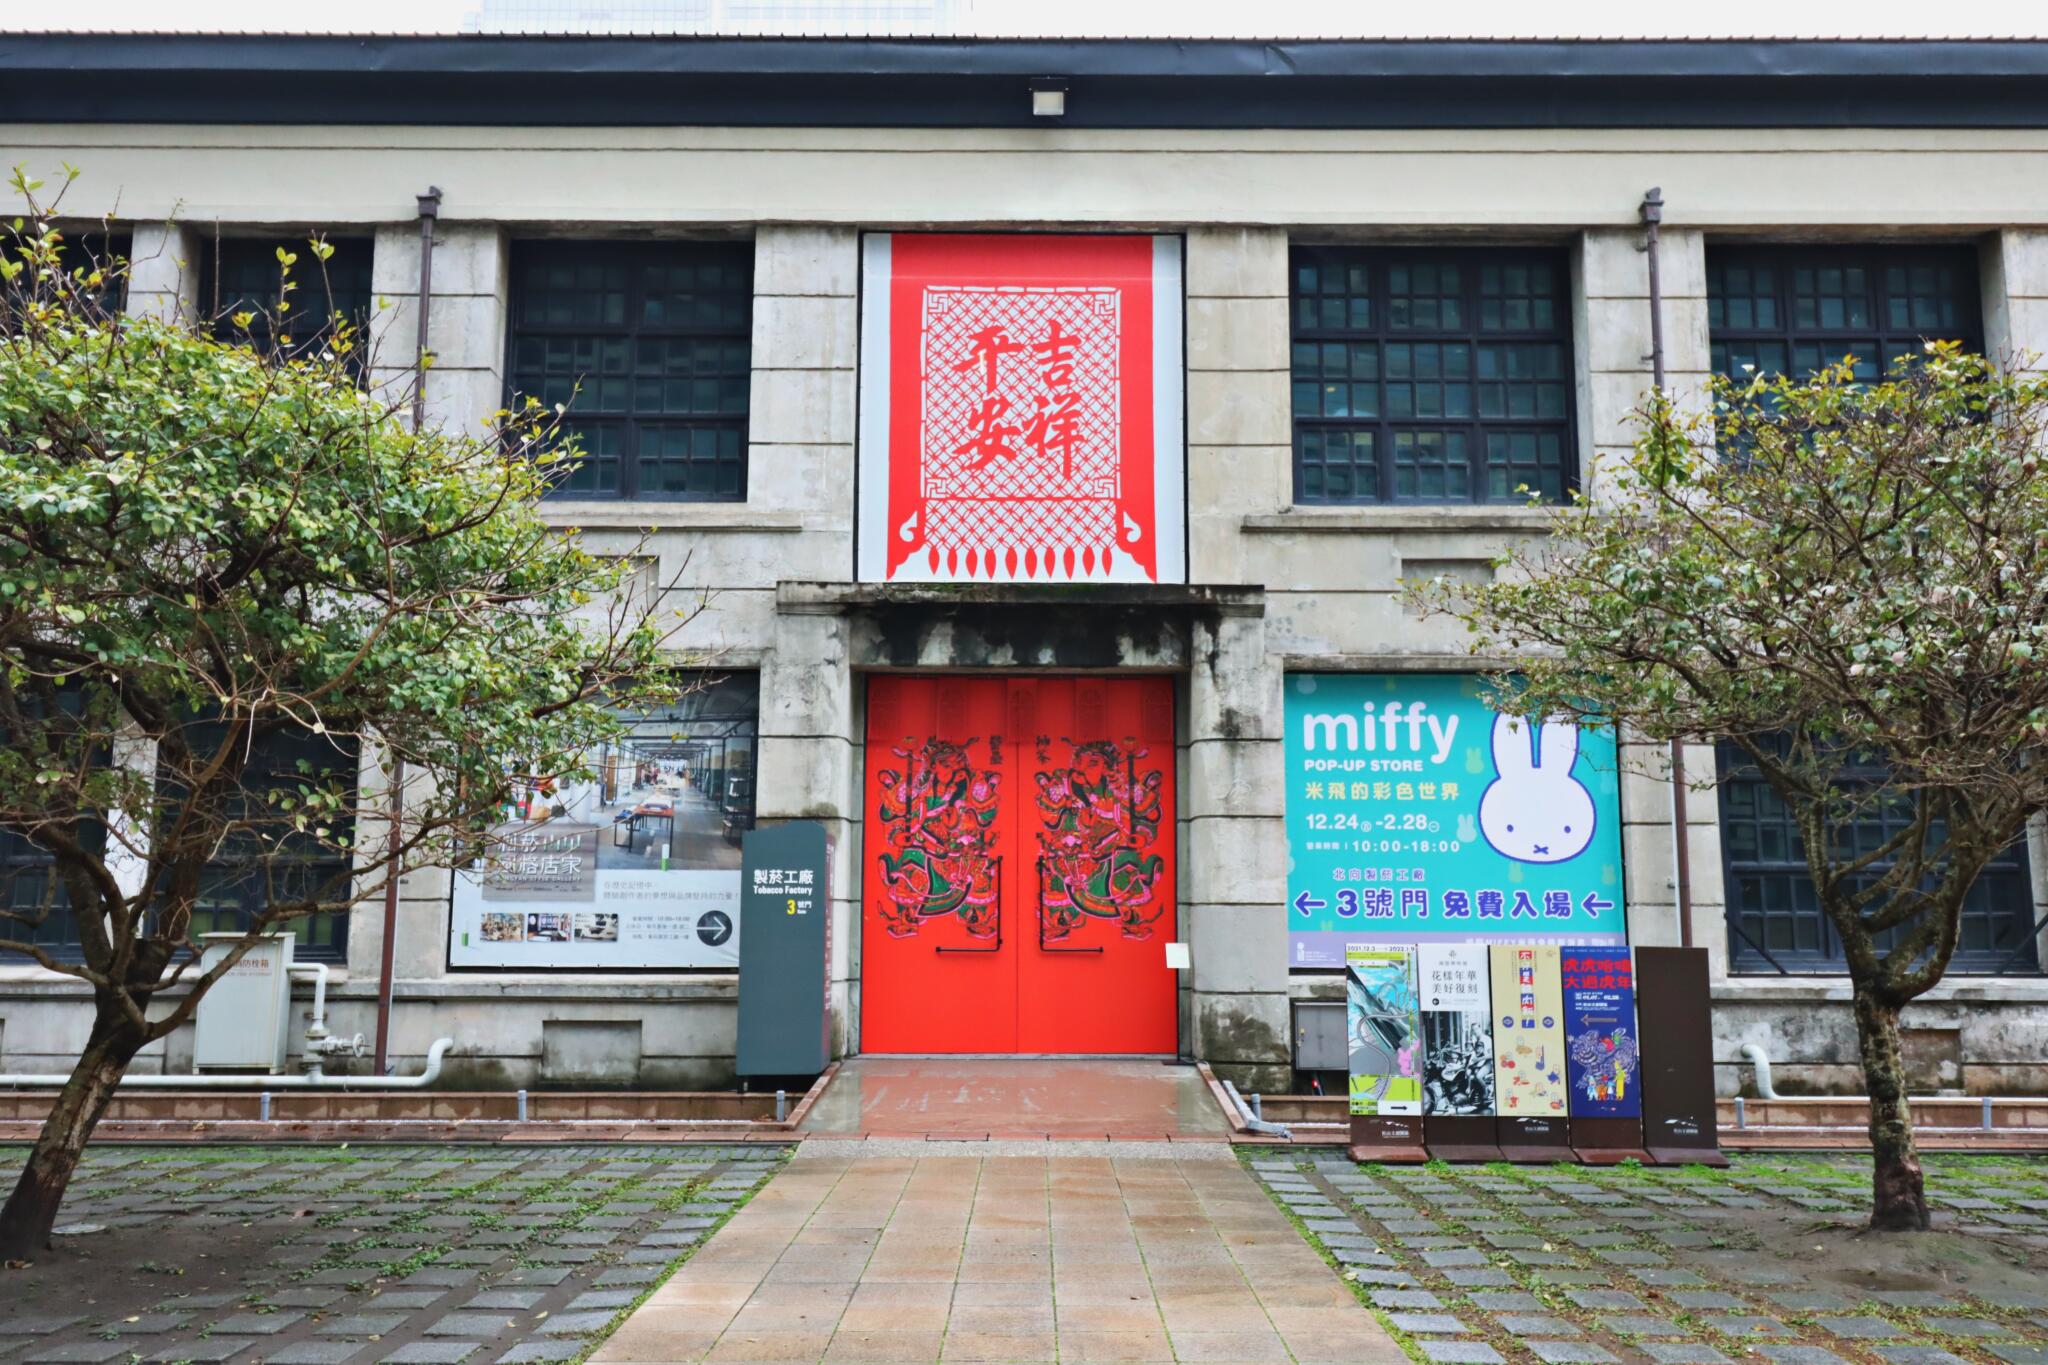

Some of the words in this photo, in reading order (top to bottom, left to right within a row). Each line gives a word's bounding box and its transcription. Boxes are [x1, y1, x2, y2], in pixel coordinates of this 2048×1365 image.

[1022, 319, 1088, 481] 吉祥
[1303, 701, 1459, 764] miffy
[1304, 759, 1366, 772] POP-UP
[1370, 759, 1423, 772] STORE
[1305, 781, 1459, 801] 米飛的彩色世界
[753, 869, 813, 884] 製菸工廠
[1333, 868, 1425, 881] 北向製菸工廠
[753, 885, 783, 895] Tobacco
[785, 885, 812, 896] Factory
[786, 899, 796, 915] 3
[1442, 889, 1573, 918] 免費入場
[1432, 970, 1477, 981] 花樣年華
